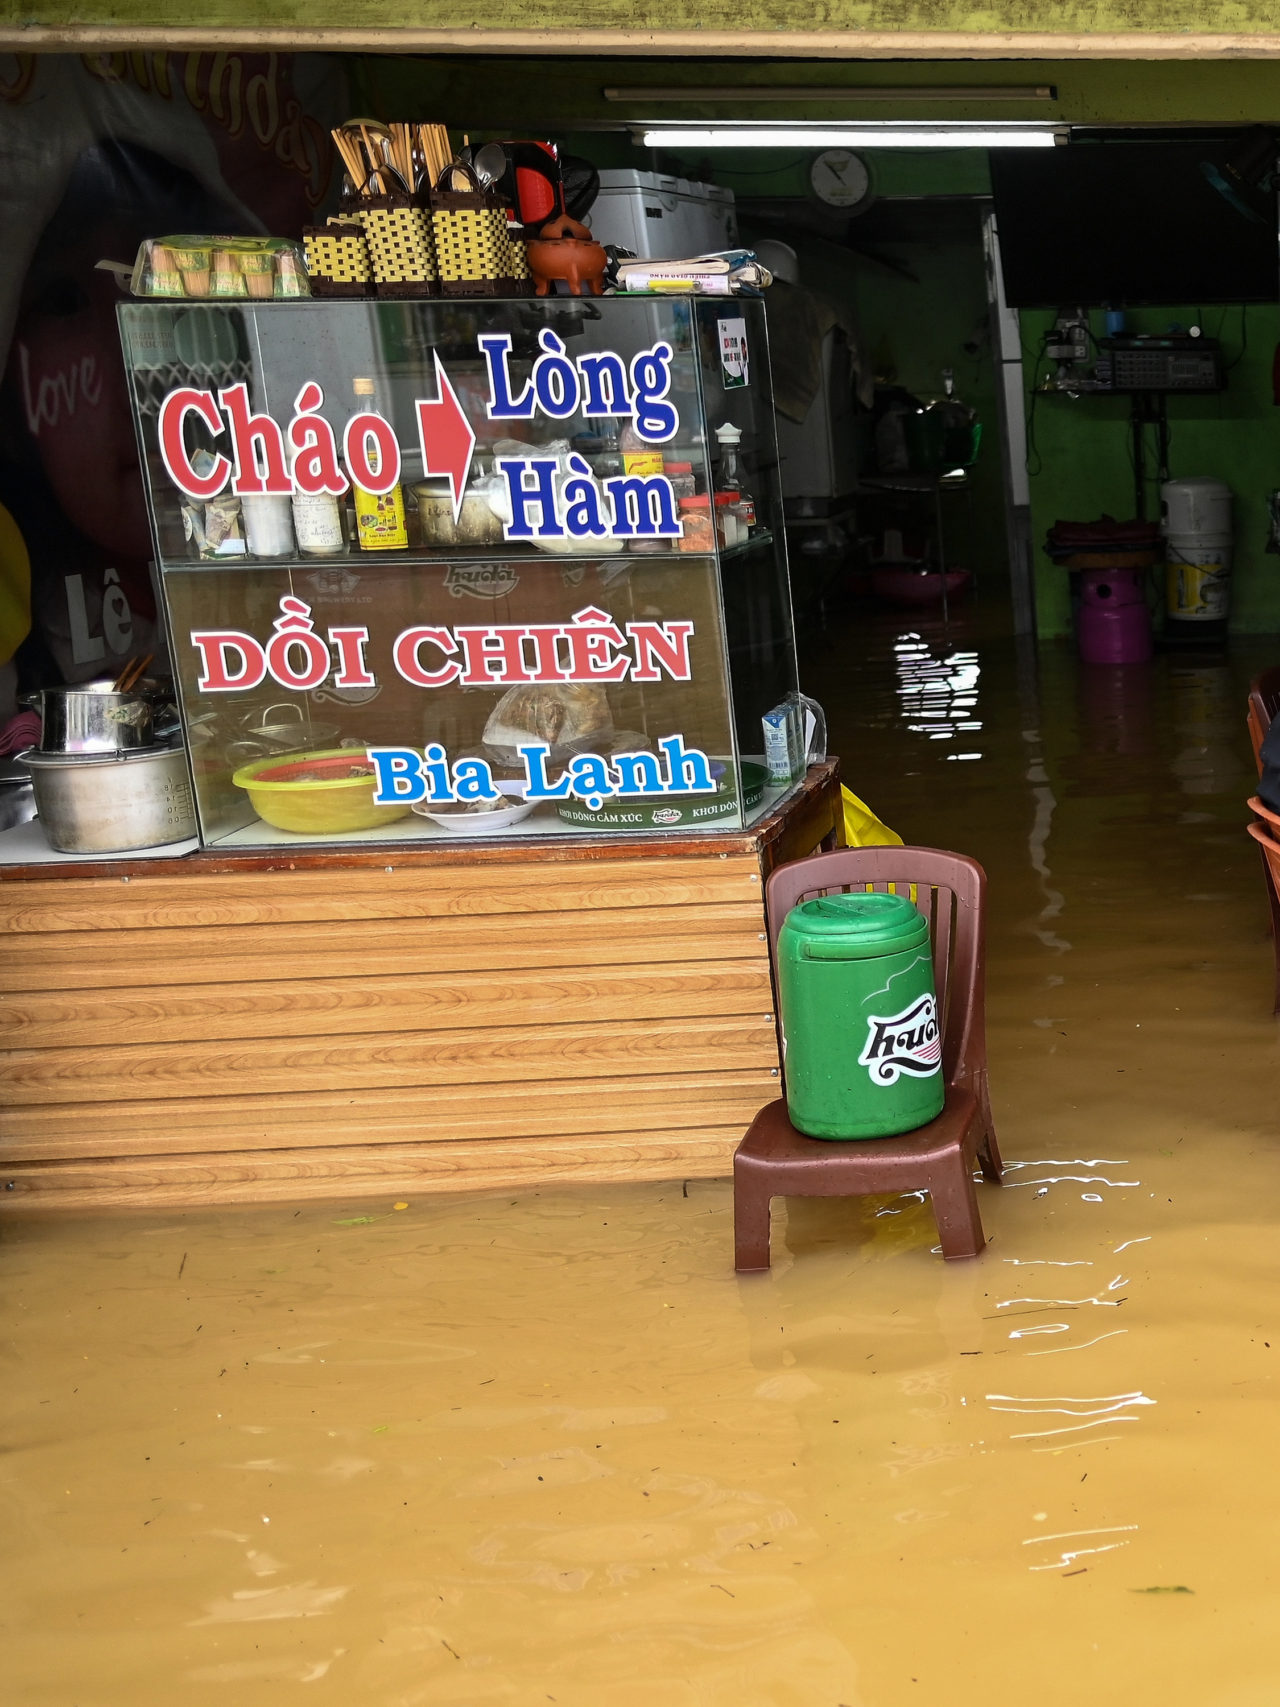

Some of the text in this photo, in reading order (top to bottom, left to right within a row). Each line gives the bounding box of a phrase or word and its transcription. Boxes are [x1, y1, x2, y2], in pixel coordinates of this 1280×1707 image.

[18, 341, 104, 436] love
[478, 327, 679, 443] Lòng
[158, 382, 401, 499] Cháo
[501, 454, 684, 540] Hàm
[190, 595, 375, 692] DỒI
[393, 605, 694, 687] CHIÊN
[366, 734, 717, 812] Bia Lạnh
[692, 806, 719, 818] KHƠI
[719, 799, 738, 812] DÒN
[862, 997, 941, 1064] hud
